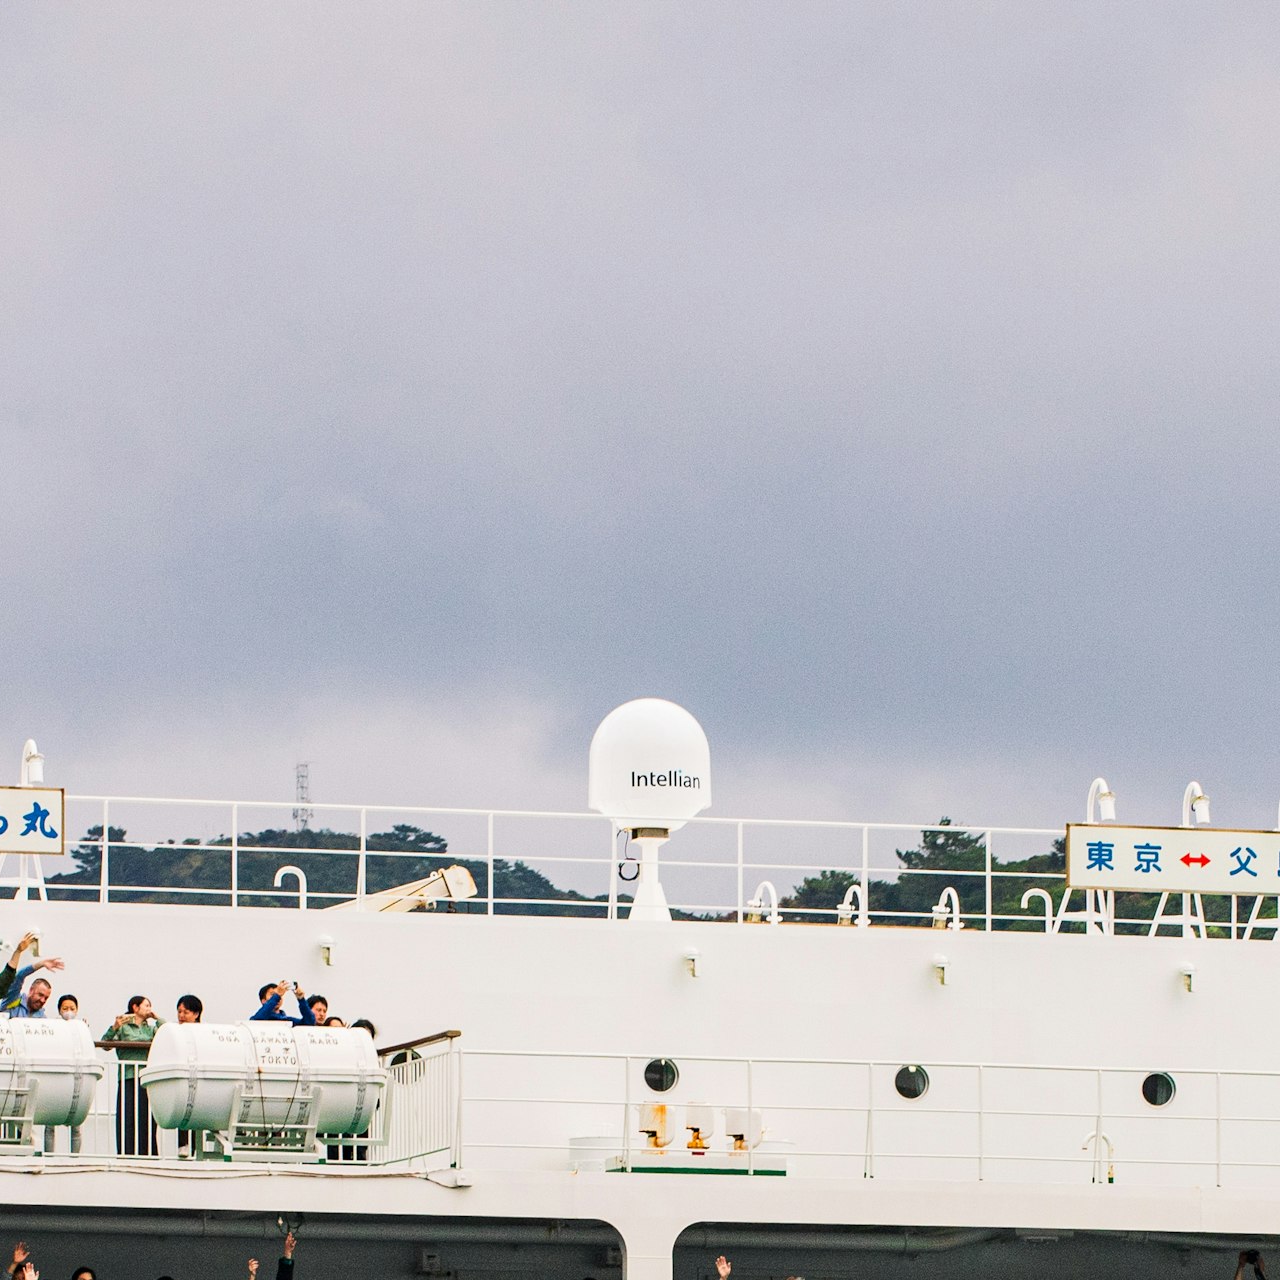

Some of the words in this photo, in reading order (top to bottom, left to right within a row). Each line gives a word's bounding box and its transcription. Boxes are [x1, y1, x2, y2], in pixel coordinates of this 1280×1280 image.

[631, 770, 701, 789] Intellian
[1086, 841, 1163, 874] 東京
[261, 1055, 297, 1065] TOKYO
